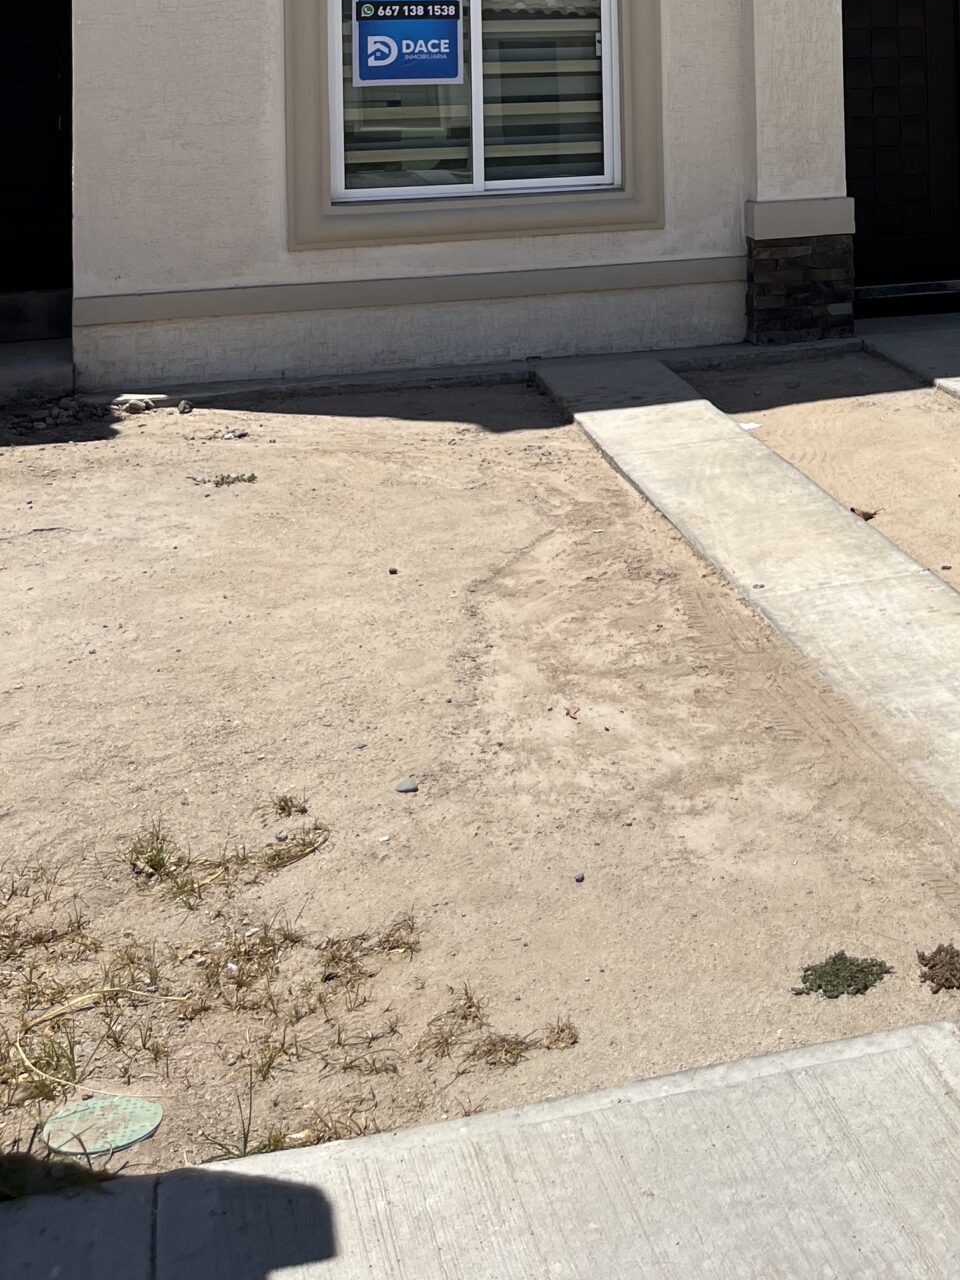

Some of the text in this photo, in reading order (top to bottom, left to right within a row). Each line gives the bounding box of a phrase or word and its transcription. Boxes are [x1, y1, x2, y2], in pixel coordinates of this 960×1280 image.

[377, 5, 456, 16] 667 138 1538
[402, 39, 450, 54] DACE
